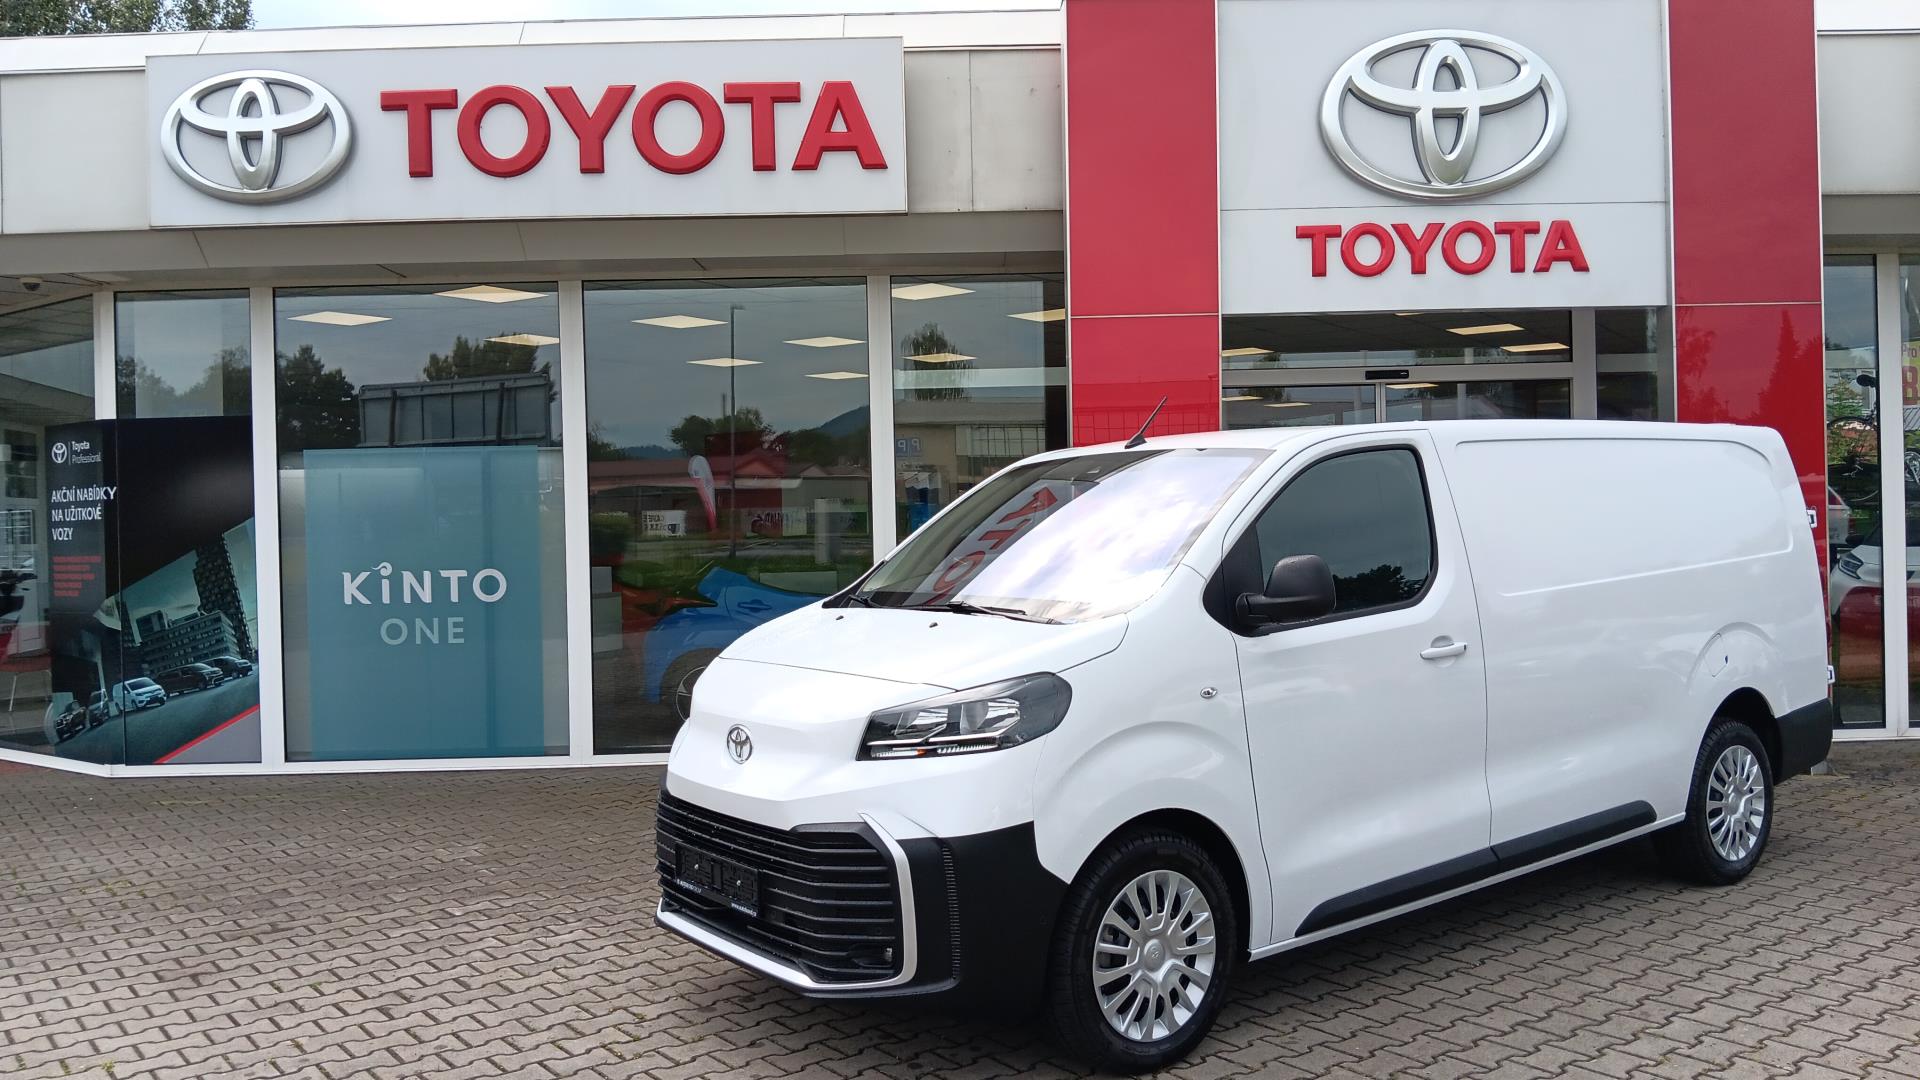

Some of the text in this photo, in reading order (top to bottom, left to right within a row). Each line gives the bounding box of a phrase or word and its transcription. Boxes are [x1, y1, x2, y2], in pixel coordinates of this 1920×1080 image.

[380, 80, 889, 178] TOYOTA
[1296, 220, 1590, 277] TOYOTA
[71, 441, 90, 452] Toyota
[51, 484, 117, 503] AKČNÍ NABÍDKY
[51, 503, 102, 522] NA UŽITKOVÉ
[51, 527, 74, 541] VOZY
[380, 616, 465, 645] ONE
